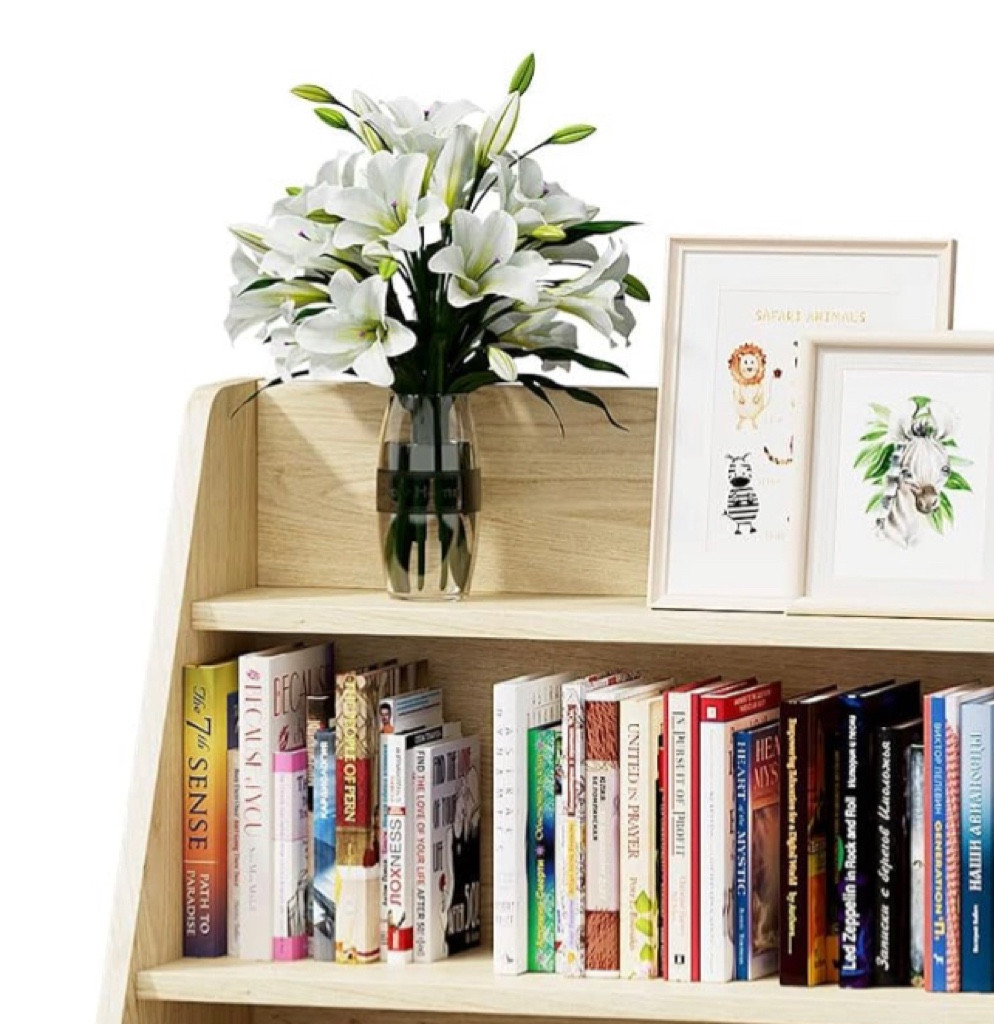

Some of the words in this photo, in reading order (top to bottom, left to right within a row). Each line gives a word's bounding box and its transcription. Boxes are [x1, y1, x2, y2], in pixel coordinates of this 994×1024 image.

[755, 308, 801, 323] SAFARI
[626, 723, 639, 783] UNITED
[933, 722, 943, 765] ВИКТОР
[344, 763, 357, 785] OF
[416, 750, 426, 773] FIND
[736, 741, 747, 802] HEART
[416, 774, 426, 791] THE
[627, 787, 638, 800] IN
[933, 766, 943, 816] ПЕЛЕВИН
[188, 756, 209, 851] SENSE
[344, 785, 357, 823] PERN
[416, 794, 426, 819] LOVE
[844, 795, 857, 818] Roll
[416, 821, 426, 836] OF
[626, 803, 640, 860] PRAYER
[845, 819, 857, 839] and
[416, 837, 426, 864] YOUR
[736, 831, 748, 897] MYSTIC
[844, 840, 857, 869] Rock
[876, 825, 893, 883] берегов
[416, 865, 426, 885] LIFE
[844, 870, 857, 881] in
[933, 819, 944, 915] GENERATION
[969, 839, 983, 892] НАШИ
[200, 872, 211, 900] PATH
[882, 888, 891, 899] с
[187, 869, 197, 937] PARADISE
[415, 887, 426, 920] AFTER
[842, 884, 860, 943] Zeppelin
[200, 913, 211, 935] TO
[876, 904, 891, 972] Записки
[843, 944, 857, 971] Led
